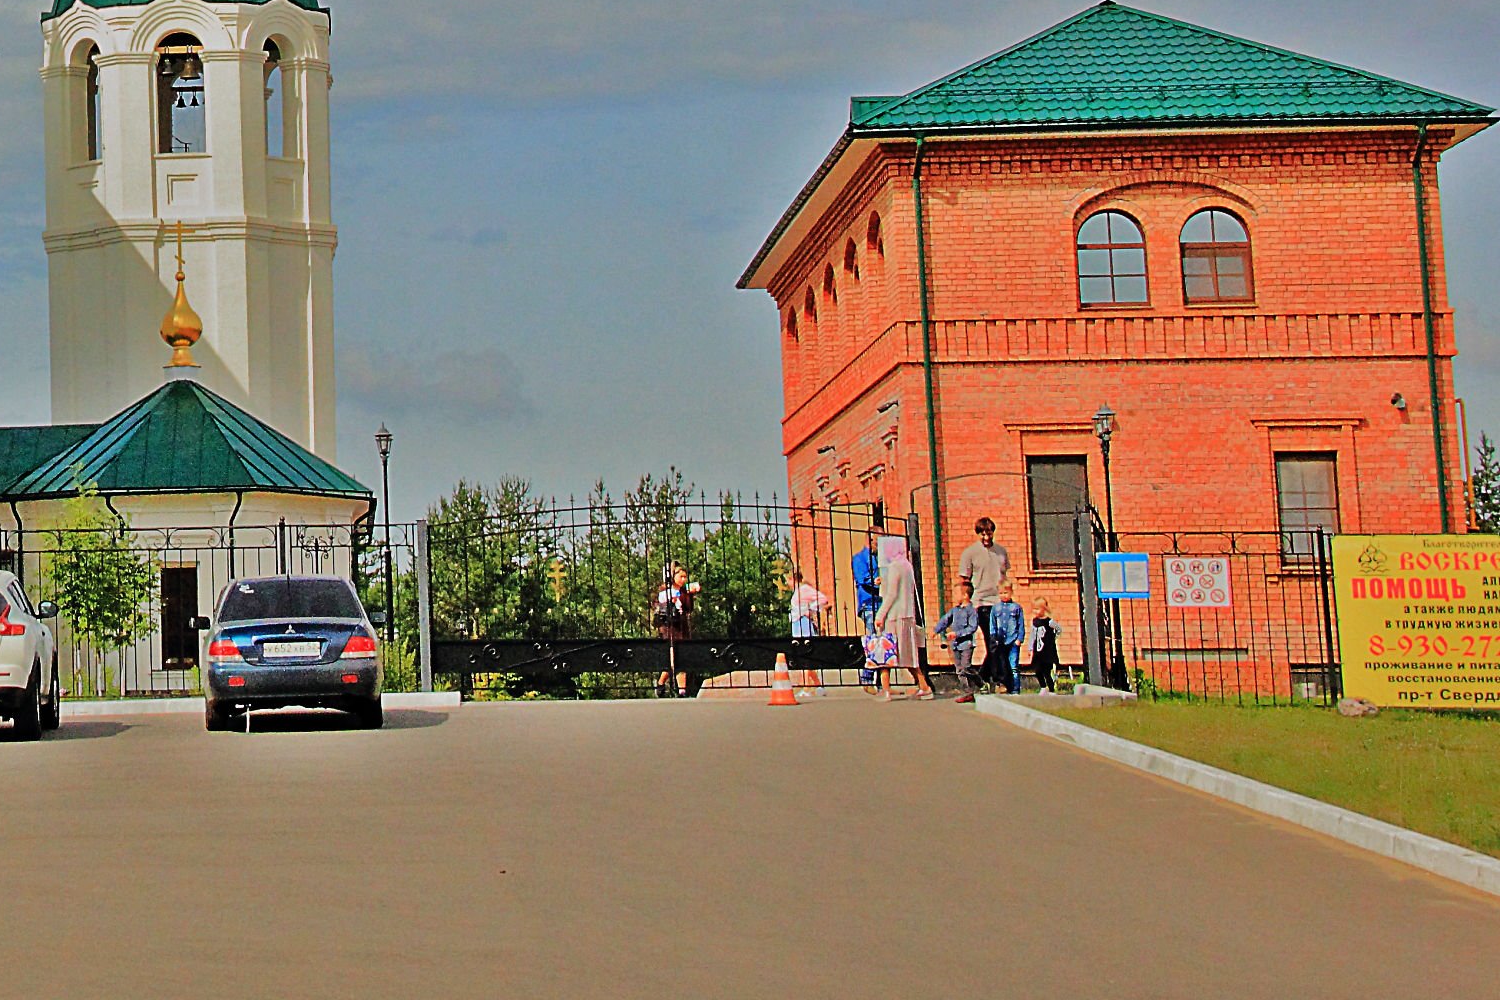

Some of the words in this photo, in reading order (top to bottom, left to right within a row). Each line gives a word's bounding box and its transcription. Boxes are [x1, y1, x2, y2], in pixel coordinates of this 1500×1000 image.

[1482, 576, 1500, 586] АЛ
[1351, 577, 1467, 602] ПОМОЩЬ
[1484, 590, 1500, 600] НА
[1403, 605, 1411, 614] а
[1414, 605, 1454, 614] также
[1385, 620, 1392, 628] в
[1394, 620, 1452, 630] трудную
[1455, 620, 1500, 629] жизне
[1364, 661, 1453, 671] проживание
[1457, 662, 1465, 670] и
[1398, 690, 1433, 702] пр-т
